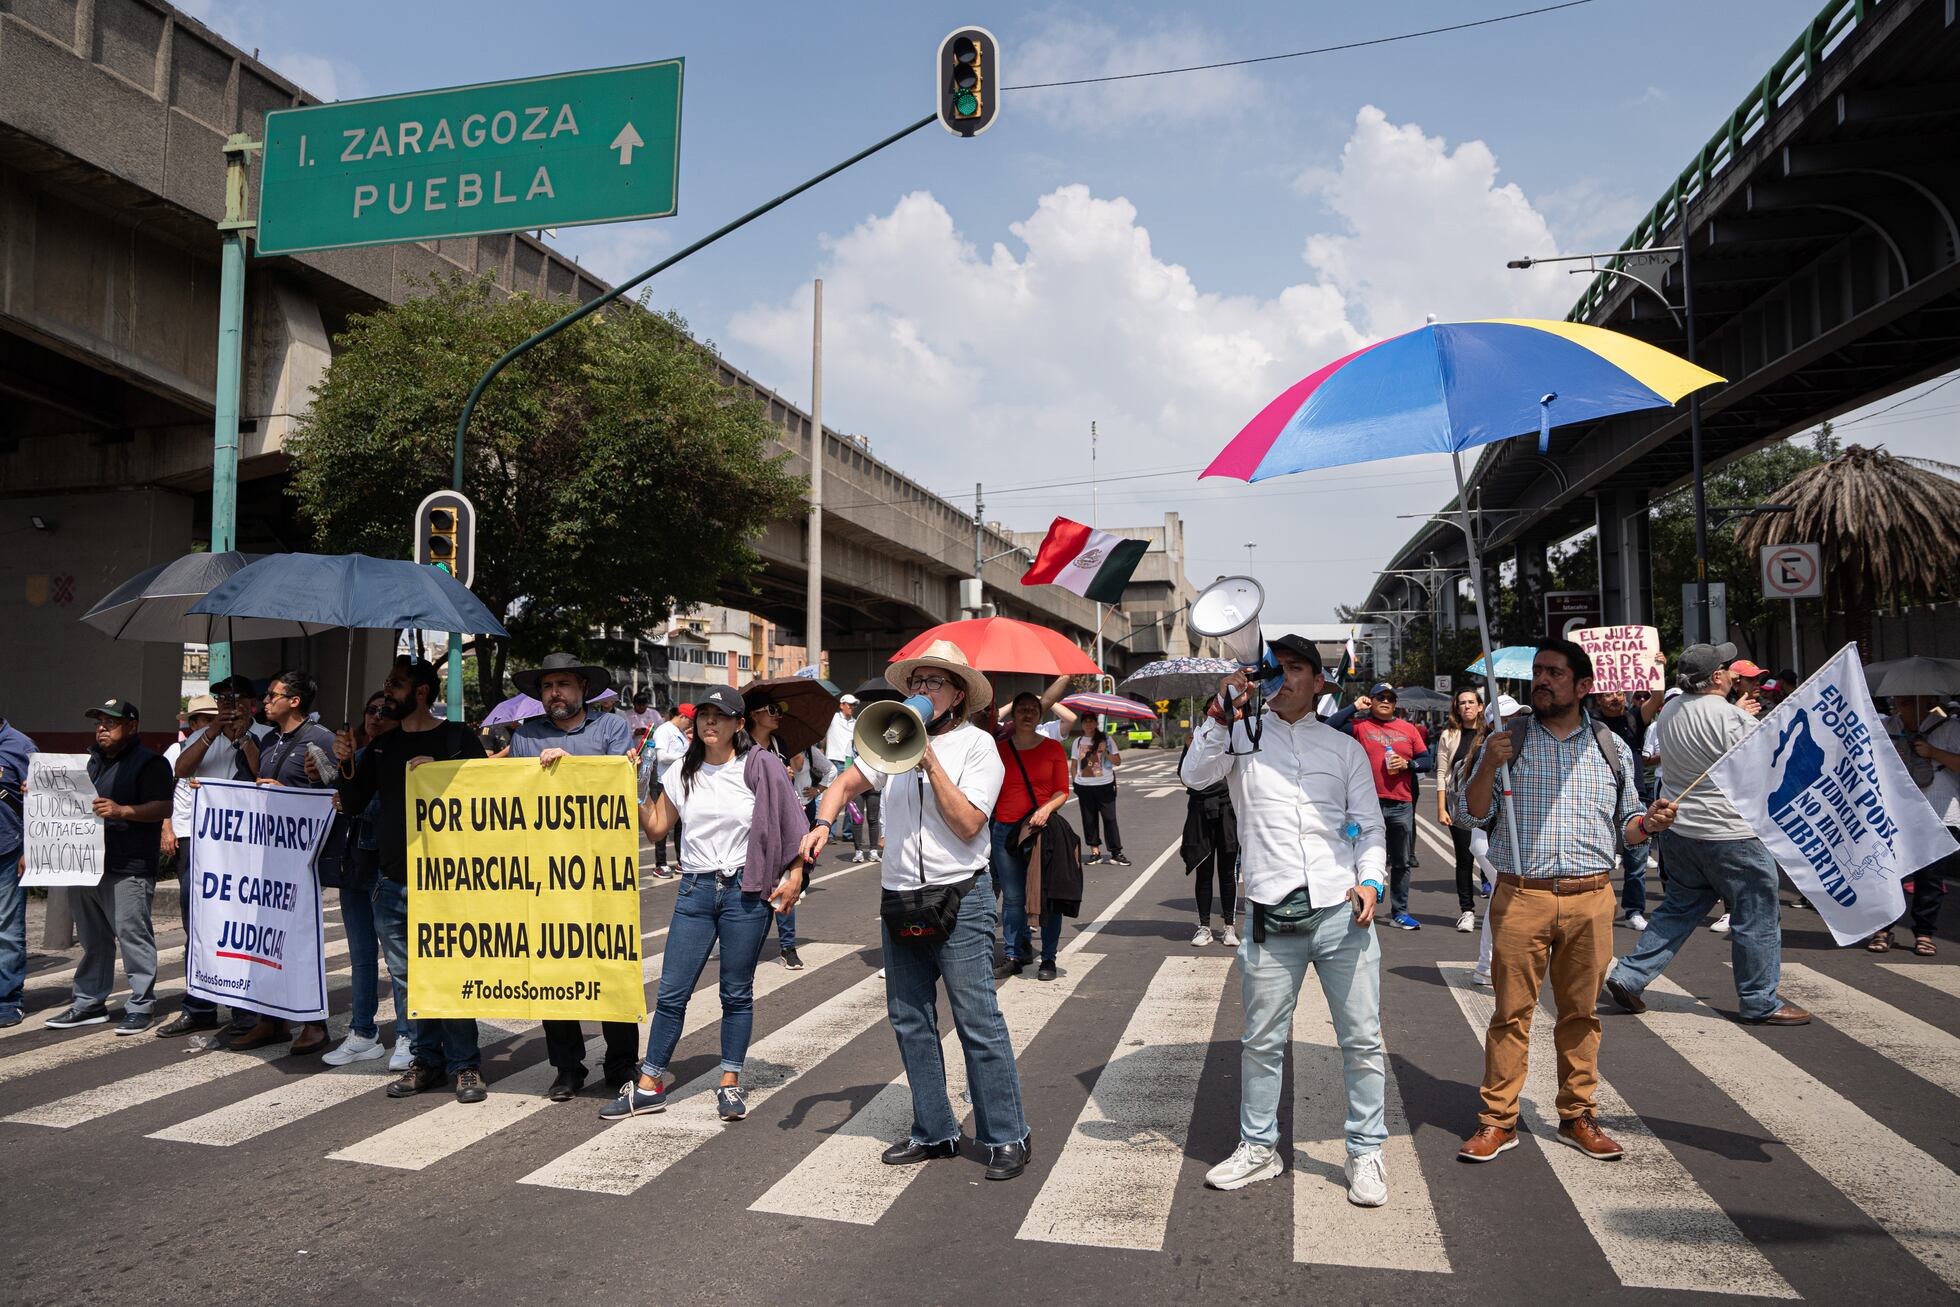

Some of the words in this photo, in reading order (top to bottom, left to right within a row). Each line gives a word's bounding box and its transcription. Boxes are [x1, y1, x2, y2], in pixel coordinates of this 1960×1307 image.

[299, 135, 315, 167] I.
[340, 104, 580, 162] ZARAGOZA
[353, 166, 556, 219] PUEBLA
[1580, 630, 1600, 641] EL
[1604, 626, 1645, 640] JUEZ
[1593, 666, 1660, 681] RRERA
[1596, 654, 1615, 667] ES
[1620, 653, 1643, 667] DE
[1819, 684, 1849, 714] EN
[1811, 699, 1865, 761] PODER
[1832, 755, 1865, 794] SIN
[28, 793, 93, 818] JUDICIAL
[416, 797, 463, 832] POR
[471, 796, 527, 831] UNA
[533, 794, 631, 830] JUSTICIA
[1795, 790, 1822, 817] NO
[1815, 812, 1846, 849] HAY
[1812, 774, 1869, 845] JUDICIAL
[28, 820, 97, 839] CONTRAPESO
[198, 807, 245, 843] JUEZ
[28, 841, 102, 875] NACIONAL
[1772, 804, 1858, 908] LIBERTAD
[202, 871, 233, 902] DE
[416, 856, 541, 896] IMPARCIAL,
[549, 855, 586, 891] NO
[592, 856, 606, 891] A
[610, 856, 636, 891] LA
[217, 920, 286, 961] JUDICIAL
[417, 922, 530, 958] REFORMA
[536, 922, 638, 961] JUDICIAL
[195, 970, 251, 992] #TodosSomosPJF
[461, 979, 601, 1000] #TodosSomosPJF
